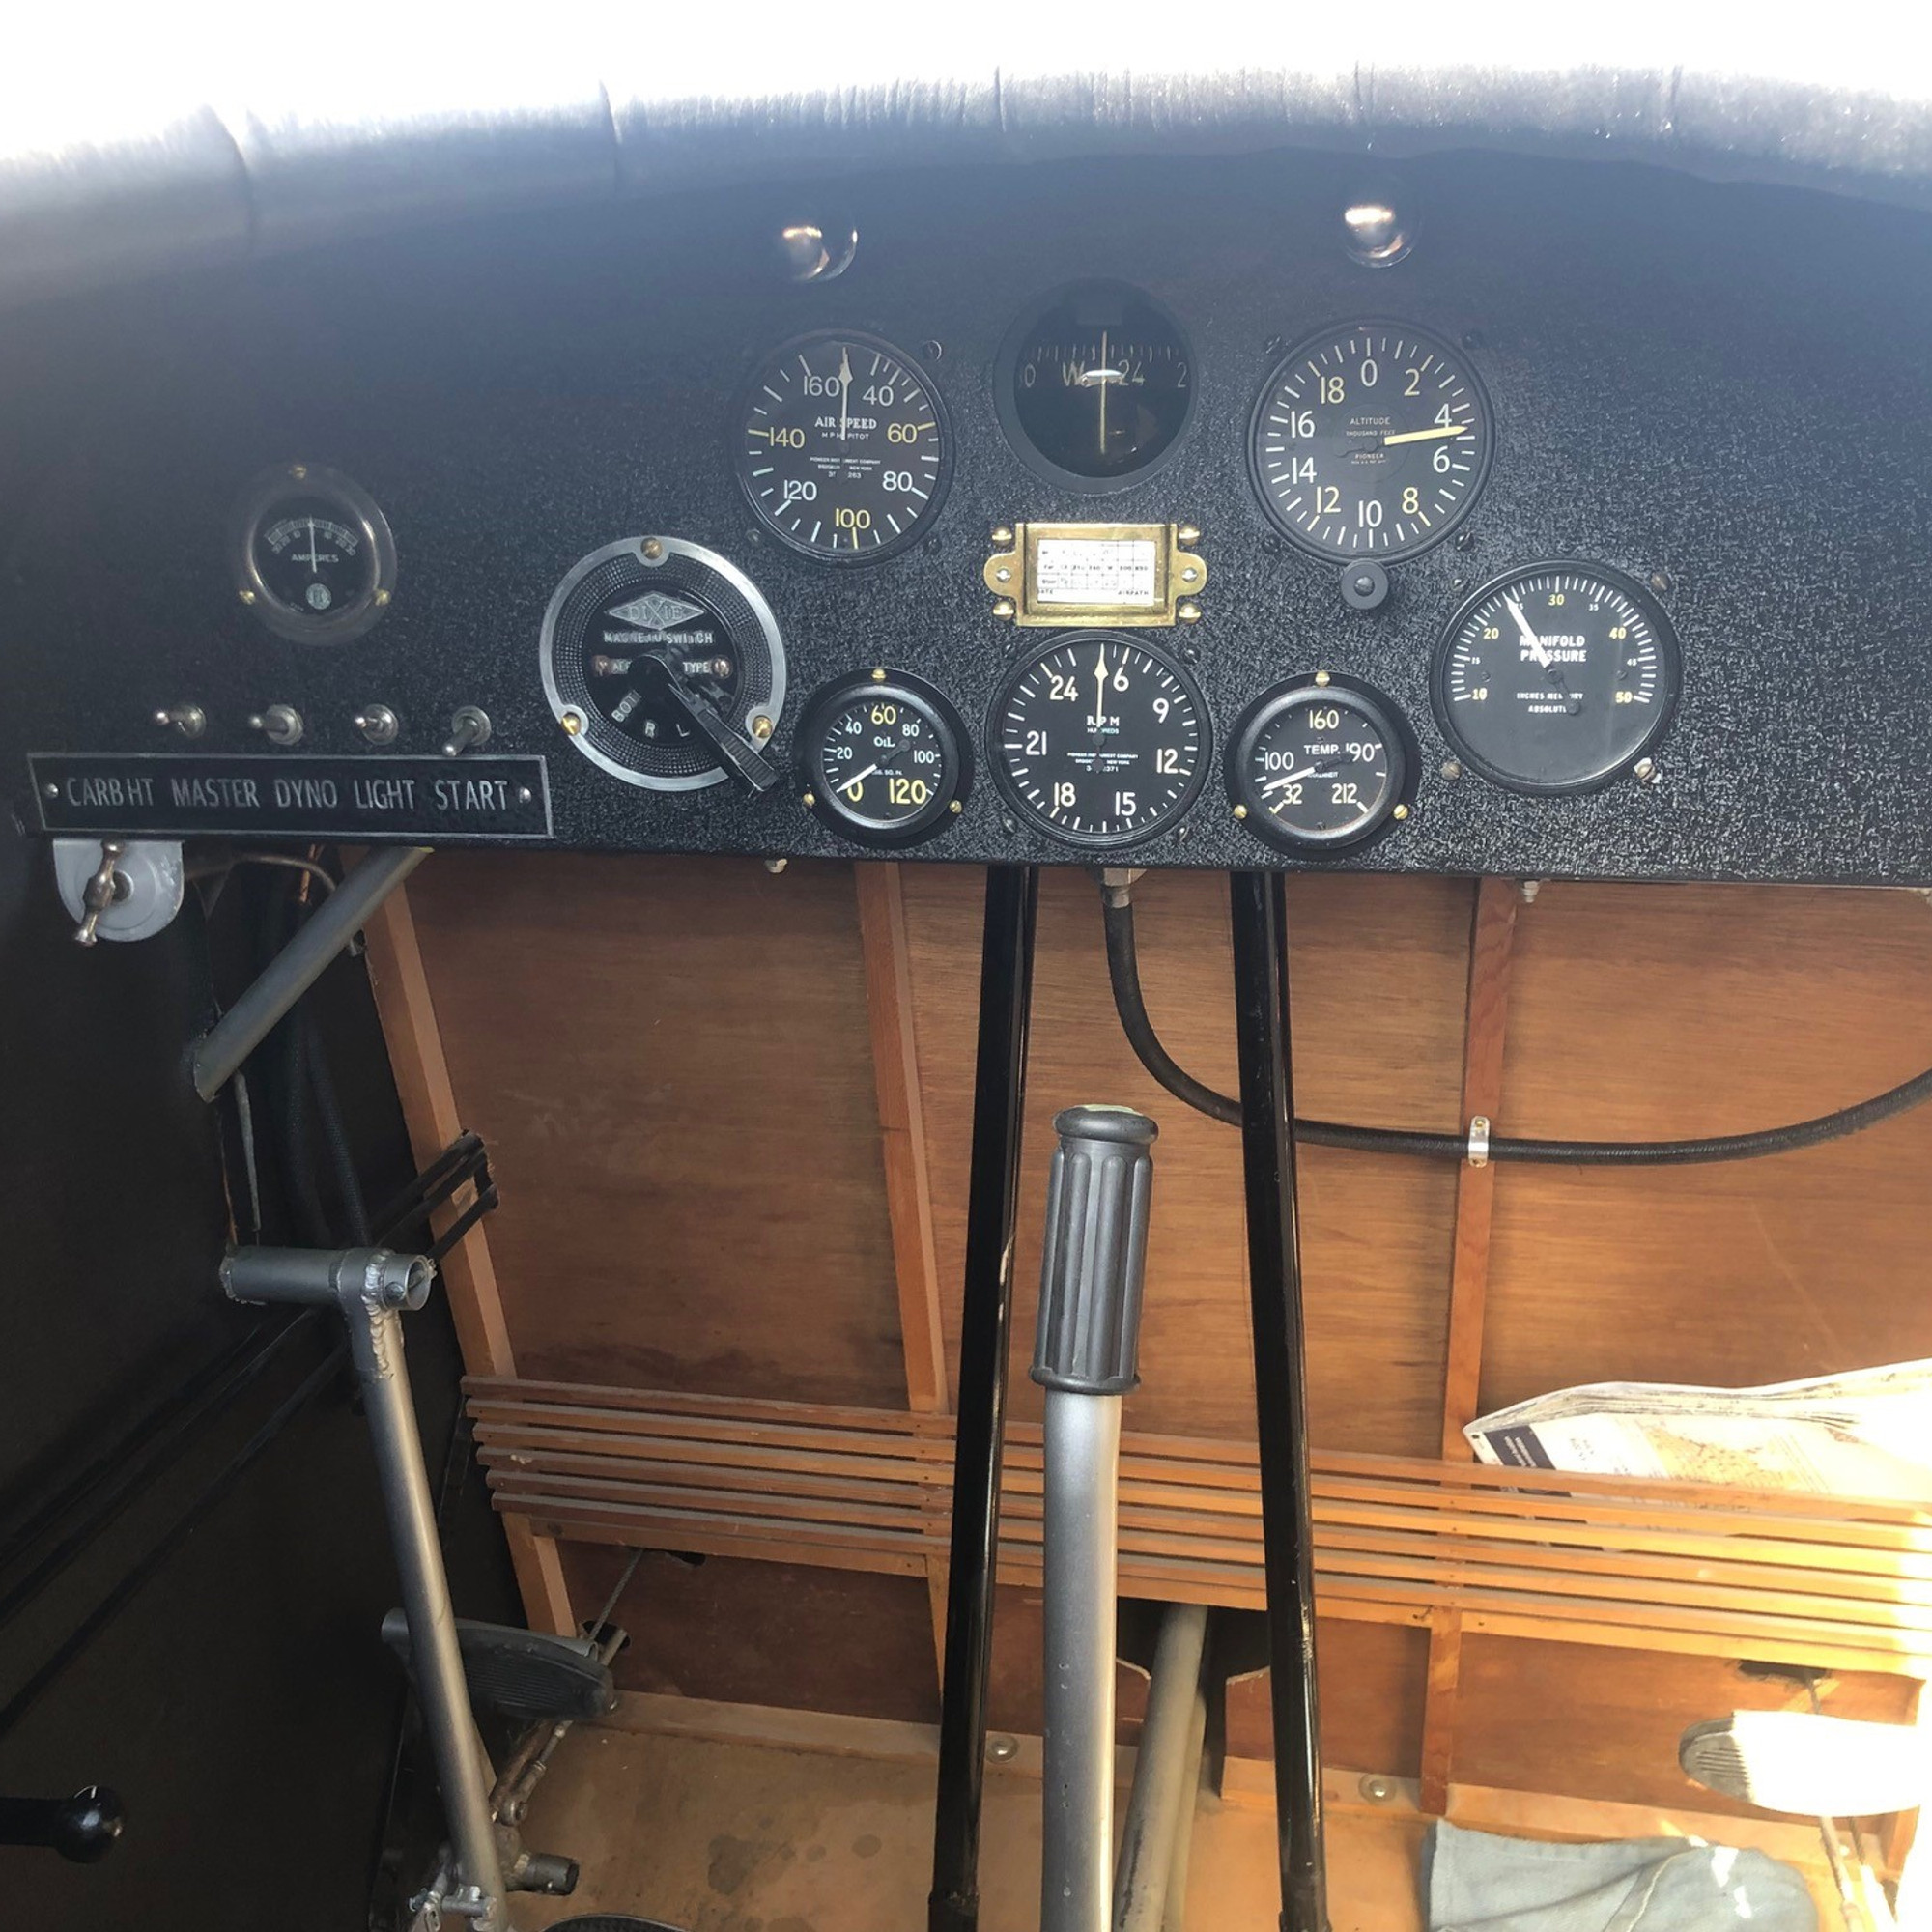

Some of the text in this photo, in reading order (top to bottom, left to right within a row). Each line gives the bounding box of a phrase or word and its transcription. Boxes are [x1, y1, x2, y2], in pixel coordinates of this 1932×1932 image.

[1360, 359, 1378, 387] 0
[1404, 368, 1420, 396] 2
[804, 376, 840, 397] 160
[863, 385, 894, 407] 40
[1321, 376, 1345, 404] 18
[814, 416, 836, 428] AIR
[1291, 411, 1316, 438] 16
[1434, 404, 1452, 428] 4
[770, 427, 806, 449] 140
[887, 423, 918, 443] 60
[1433, 445, 1451, 473] 6
[1293, 457, 1317, 484] 14
[784, 479, 817, 501] 120
[882, 471, 913, 492] 80
[1317, 486, 1342, 514] 12
[1402, 487, 1419, 514] 8
[836, 508, 871, 528] 100
[1358, 500, 1383, 527] 10
[1548, 594, 1565, 606] 30
[1588, 603, 1600, 611] 35
[627, 599, 684, 627] DIXIE
[1483, 628, 1499, 639] 20
[1520, 635, 1586, 647] MNIFOLD
[1608, 627, 1627, 639] 40
[1520, 649, 1587, 662] PRSSURE
[1626, 658, 1637, 667] 45
[682, 661, 710, 674] TYPE
[1049, 674, 1079, 702] 24
[1113, 667, 1129, 692] 6
[1471, 687, 1488, 700] 10
[1615, 691, 1633, 704] 50
[871, 704, 896, 724] 60
[1152, 697, 1170, 723] 9
[1309, 709, 1340, 730] 160
[644, 721, 657, 738] R
[675, 723, 691, 738] L
[845, 721, 862, 735] 40
[902, 724, 919, 737] 80
[873, 736, 895, 748] OIL
[1025, 730, 1047, 755] 21
[1303, 744, 1342, 755] TEMP.
[837, 747, 853, 759] 20
[913, 750, 935, 764] 100
[1156, 748, 1179, 774] 12
[1264, 751, 1294, 771] 100
[170, 778, 261, 808] MASTER
[273, 779, 338, 809] DYNO
[354, 779, 415, 810] LIGHT
[435, 779, 508, 810] START
[846, 780, 864, 802] 0
[889, 777, 927, 805] 120
[1053, 781, 1076, 807] 18
[1282, 783, 1303, 805] 32
[1331, 783, 1358, 804] 212
[1115, 791, 1137, 816] 15
